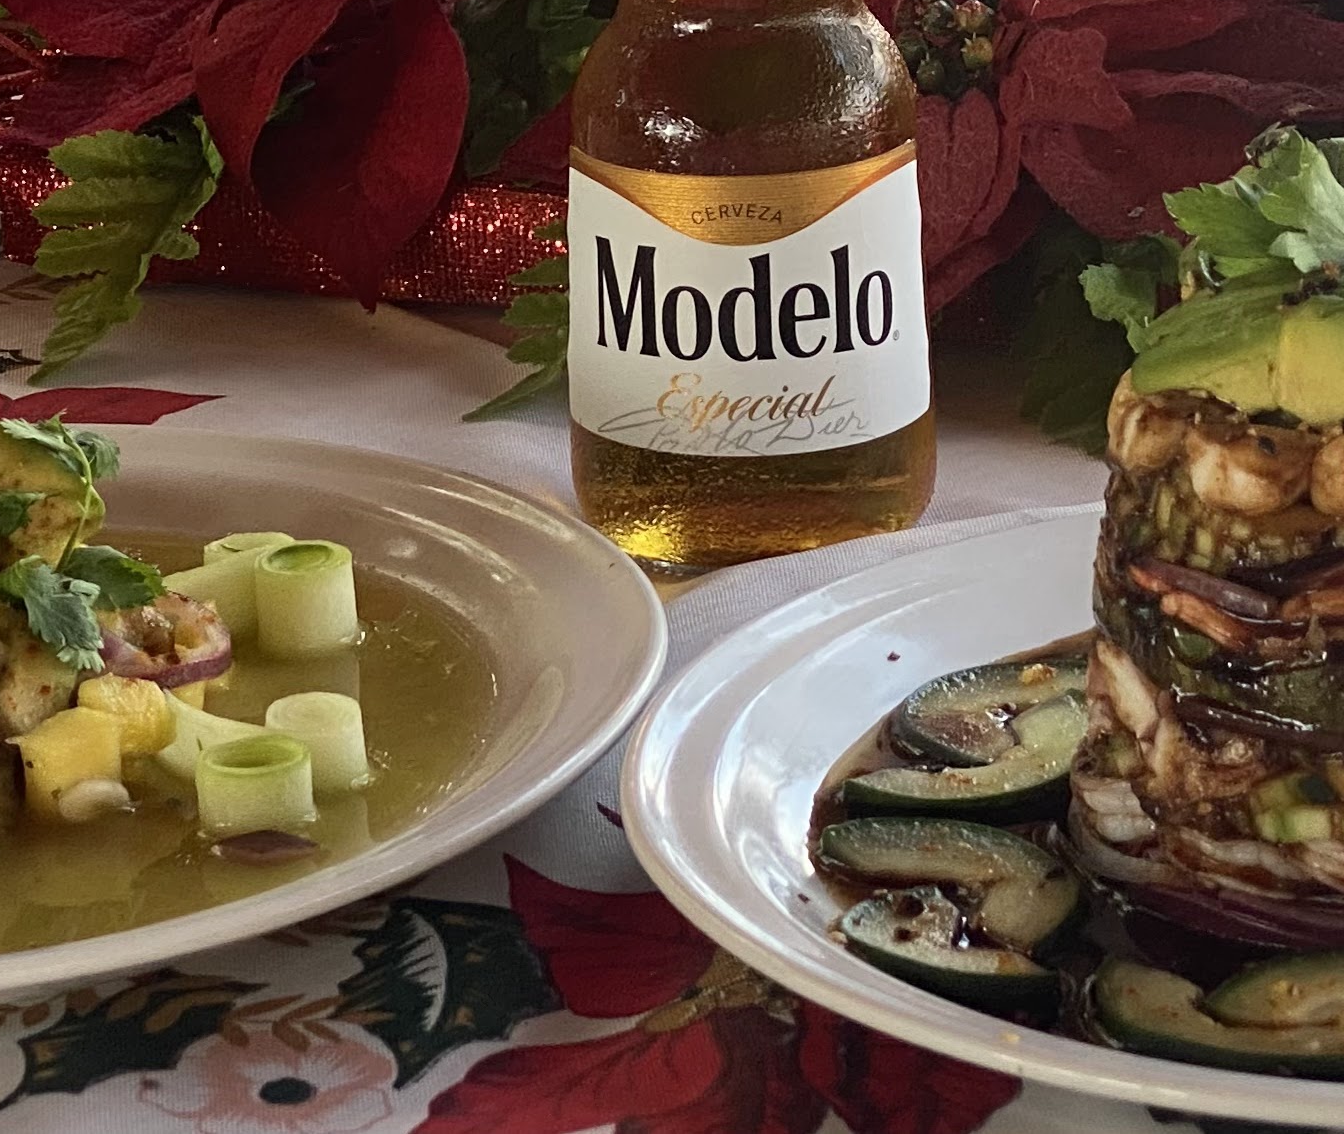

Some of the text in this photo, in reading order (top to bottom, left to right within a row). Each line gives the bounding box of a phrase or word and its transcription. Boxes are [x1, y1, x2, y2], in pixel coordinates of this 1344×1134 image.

[690, 202, 783, 226] CERVEZA
[595, 235, 894, 363] Modelo
[656, 373, 837, 433] Especial
